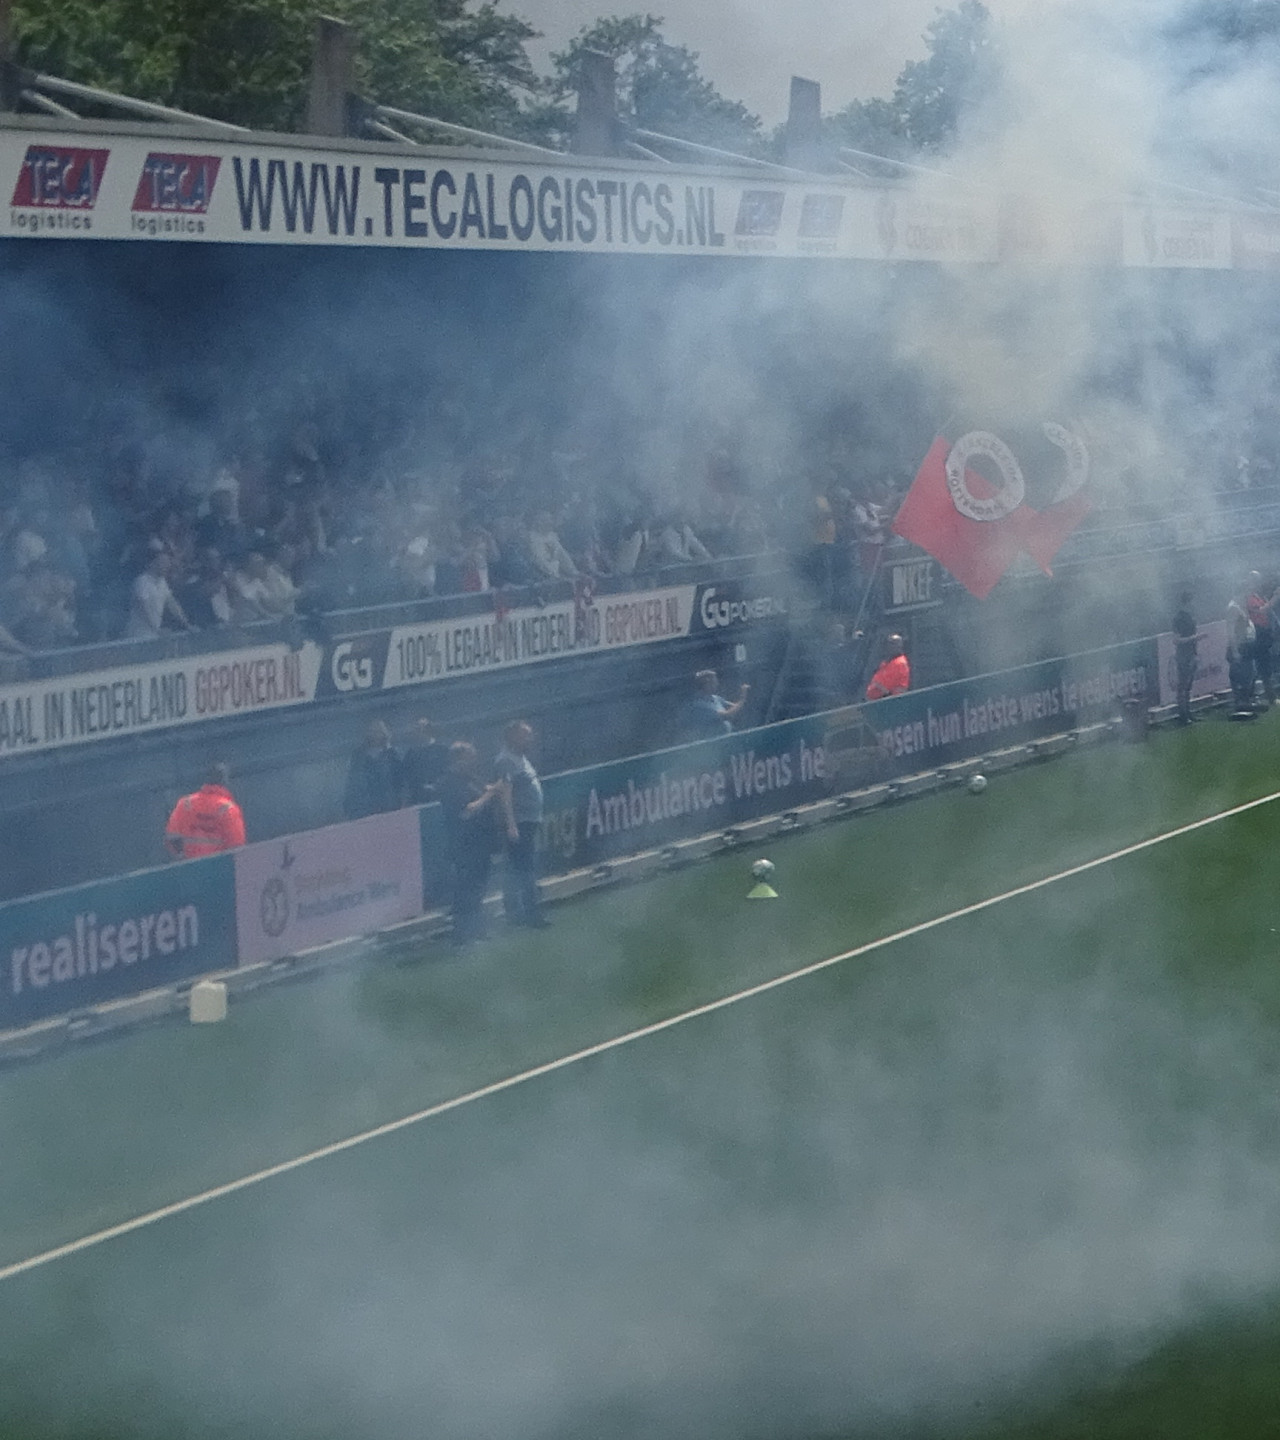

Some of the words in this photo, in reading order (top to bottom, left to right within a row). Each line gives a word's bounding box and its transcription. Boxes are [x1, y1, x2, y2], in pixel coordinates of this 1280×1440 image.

[25, 151, 95, 207] TECA
[144, 160, 209, 211] TECA
[232, 157, 724, 248] WWW.TECALOGISTICS.NL
[11, 210, 92, 233] logistics
[131, 213, 206, 235] logistics
[397, 633, 442, 681] 100%
[44, 691, 64, 741] IN
[71, 671, 187, 736] NEDERLAND
[195, 653, 306, 714] GGPOKER.NL
[928, 706, 962, 748] hun
[964, 696, 1018, 738] laatste
[584, 765, 726, 840] Ambulance
[731, 749, 790, 801] Wens
[10, 903, 200, 993] realiseren
